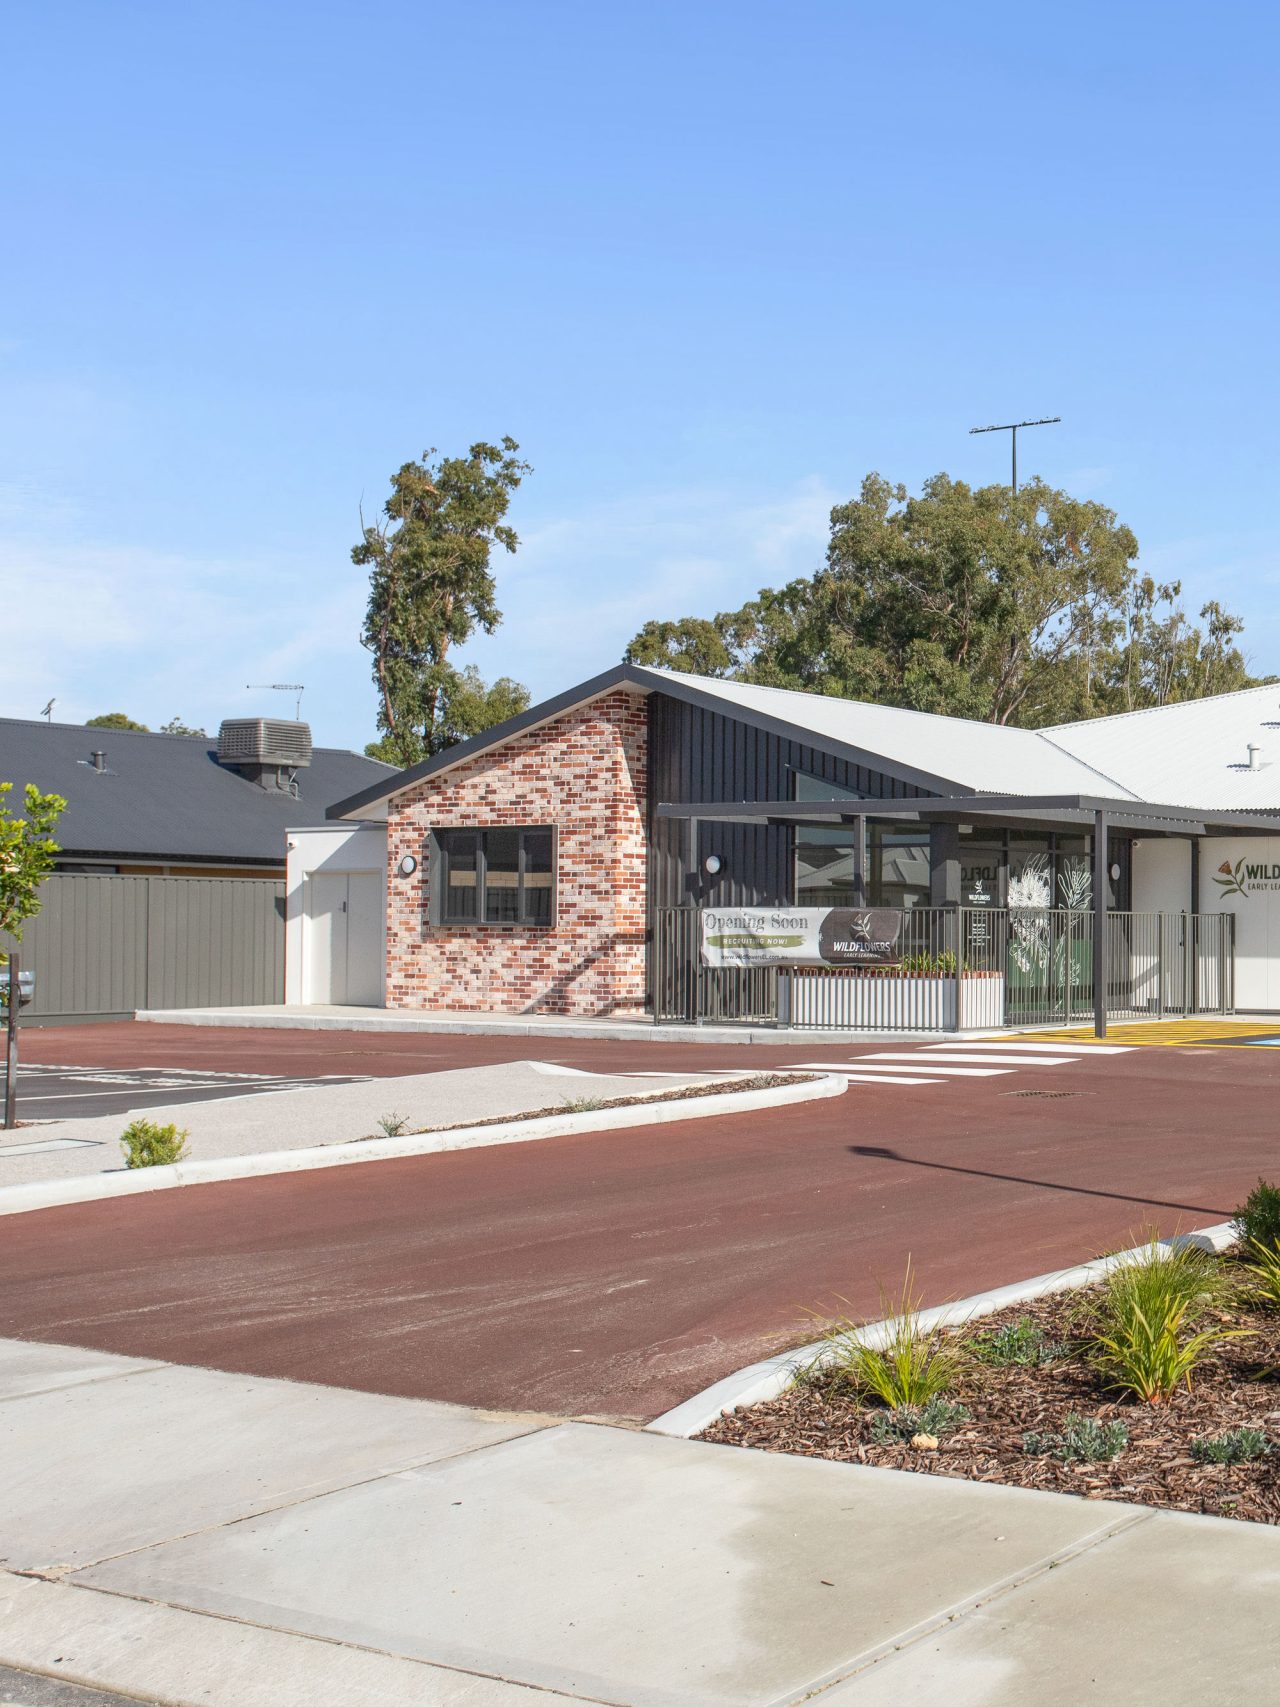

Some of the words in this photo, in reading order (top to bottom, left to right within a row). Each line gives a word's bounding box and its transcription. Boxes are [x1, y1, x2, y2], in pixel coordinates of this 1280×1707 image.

[1248, 883, 1268, 891] EARLY
[705, 912, 765, 932] Opening
[771, 912, 809, 930] Soon
[723, 937, 765, 945] RECRUITING
[767, 937, 788, 945] NOW!
[833, 941, 892, 952] WILDFLOWERS
